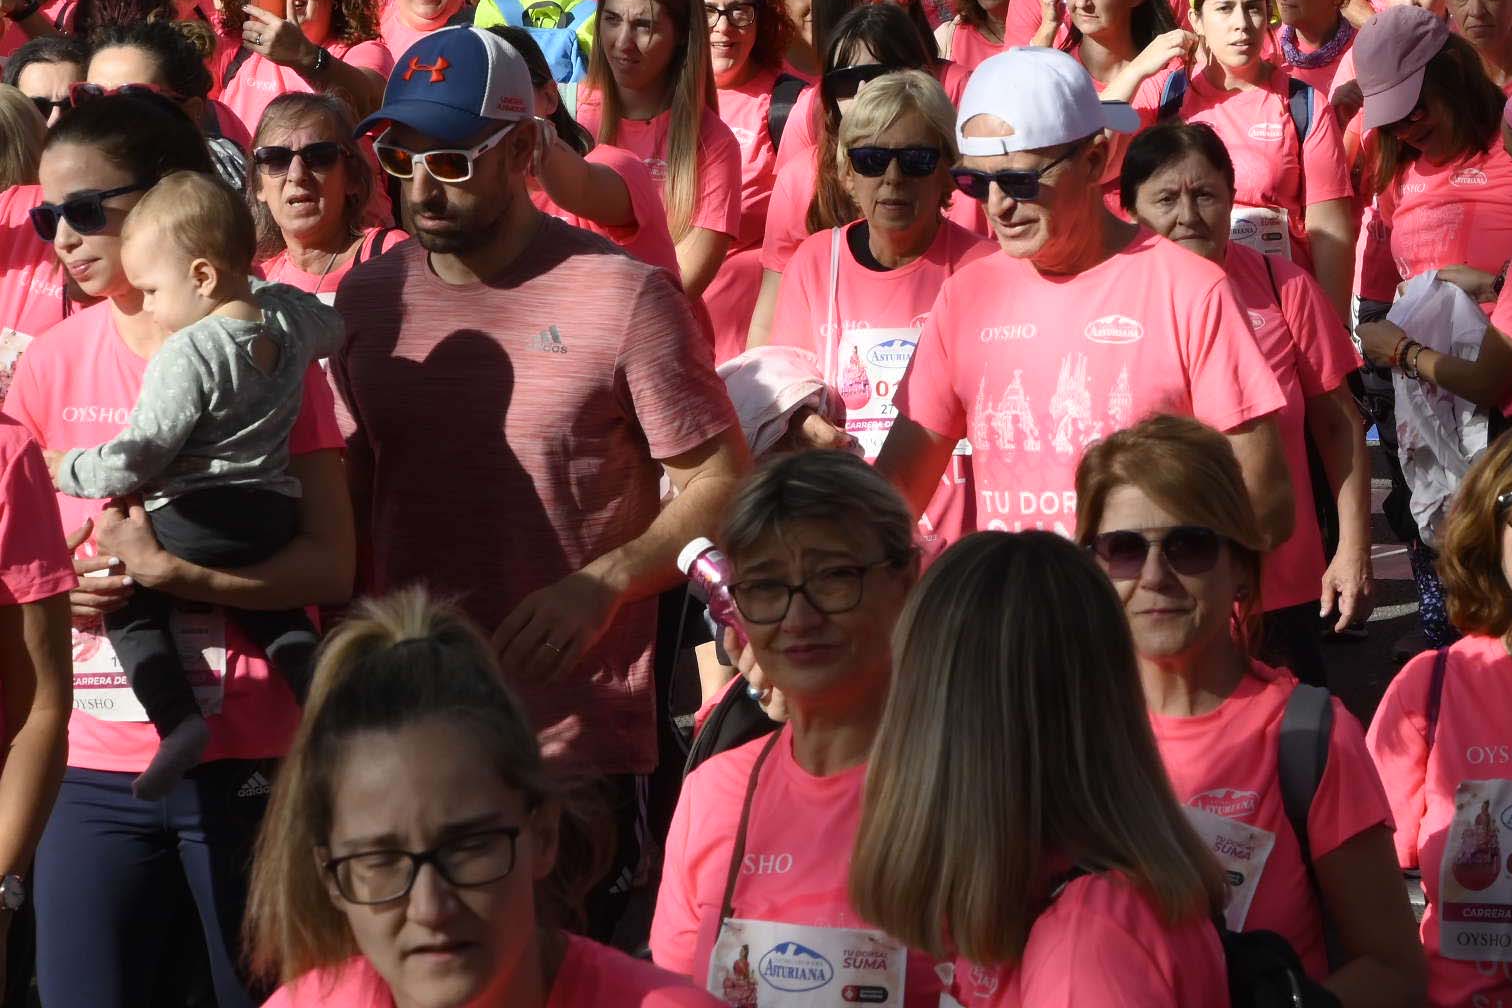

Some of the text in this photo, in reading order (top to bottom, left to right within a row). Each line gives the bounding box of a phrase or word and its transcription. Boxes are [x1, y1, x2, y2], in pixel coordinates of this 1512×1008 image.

[980, 323, 1037, 343] OYSHO
[981, 490, 1010, 514] TU
[114, 675, 128, 685] DE
[1215, 842, 1251, 861] SUMA
[742, 852, 794, 875] SHO
[1462, 906, 1512, 920] CARRERA
[1456, 931, 1512, 948] OYSHO
[843, 957, 887, 971] SUMA
